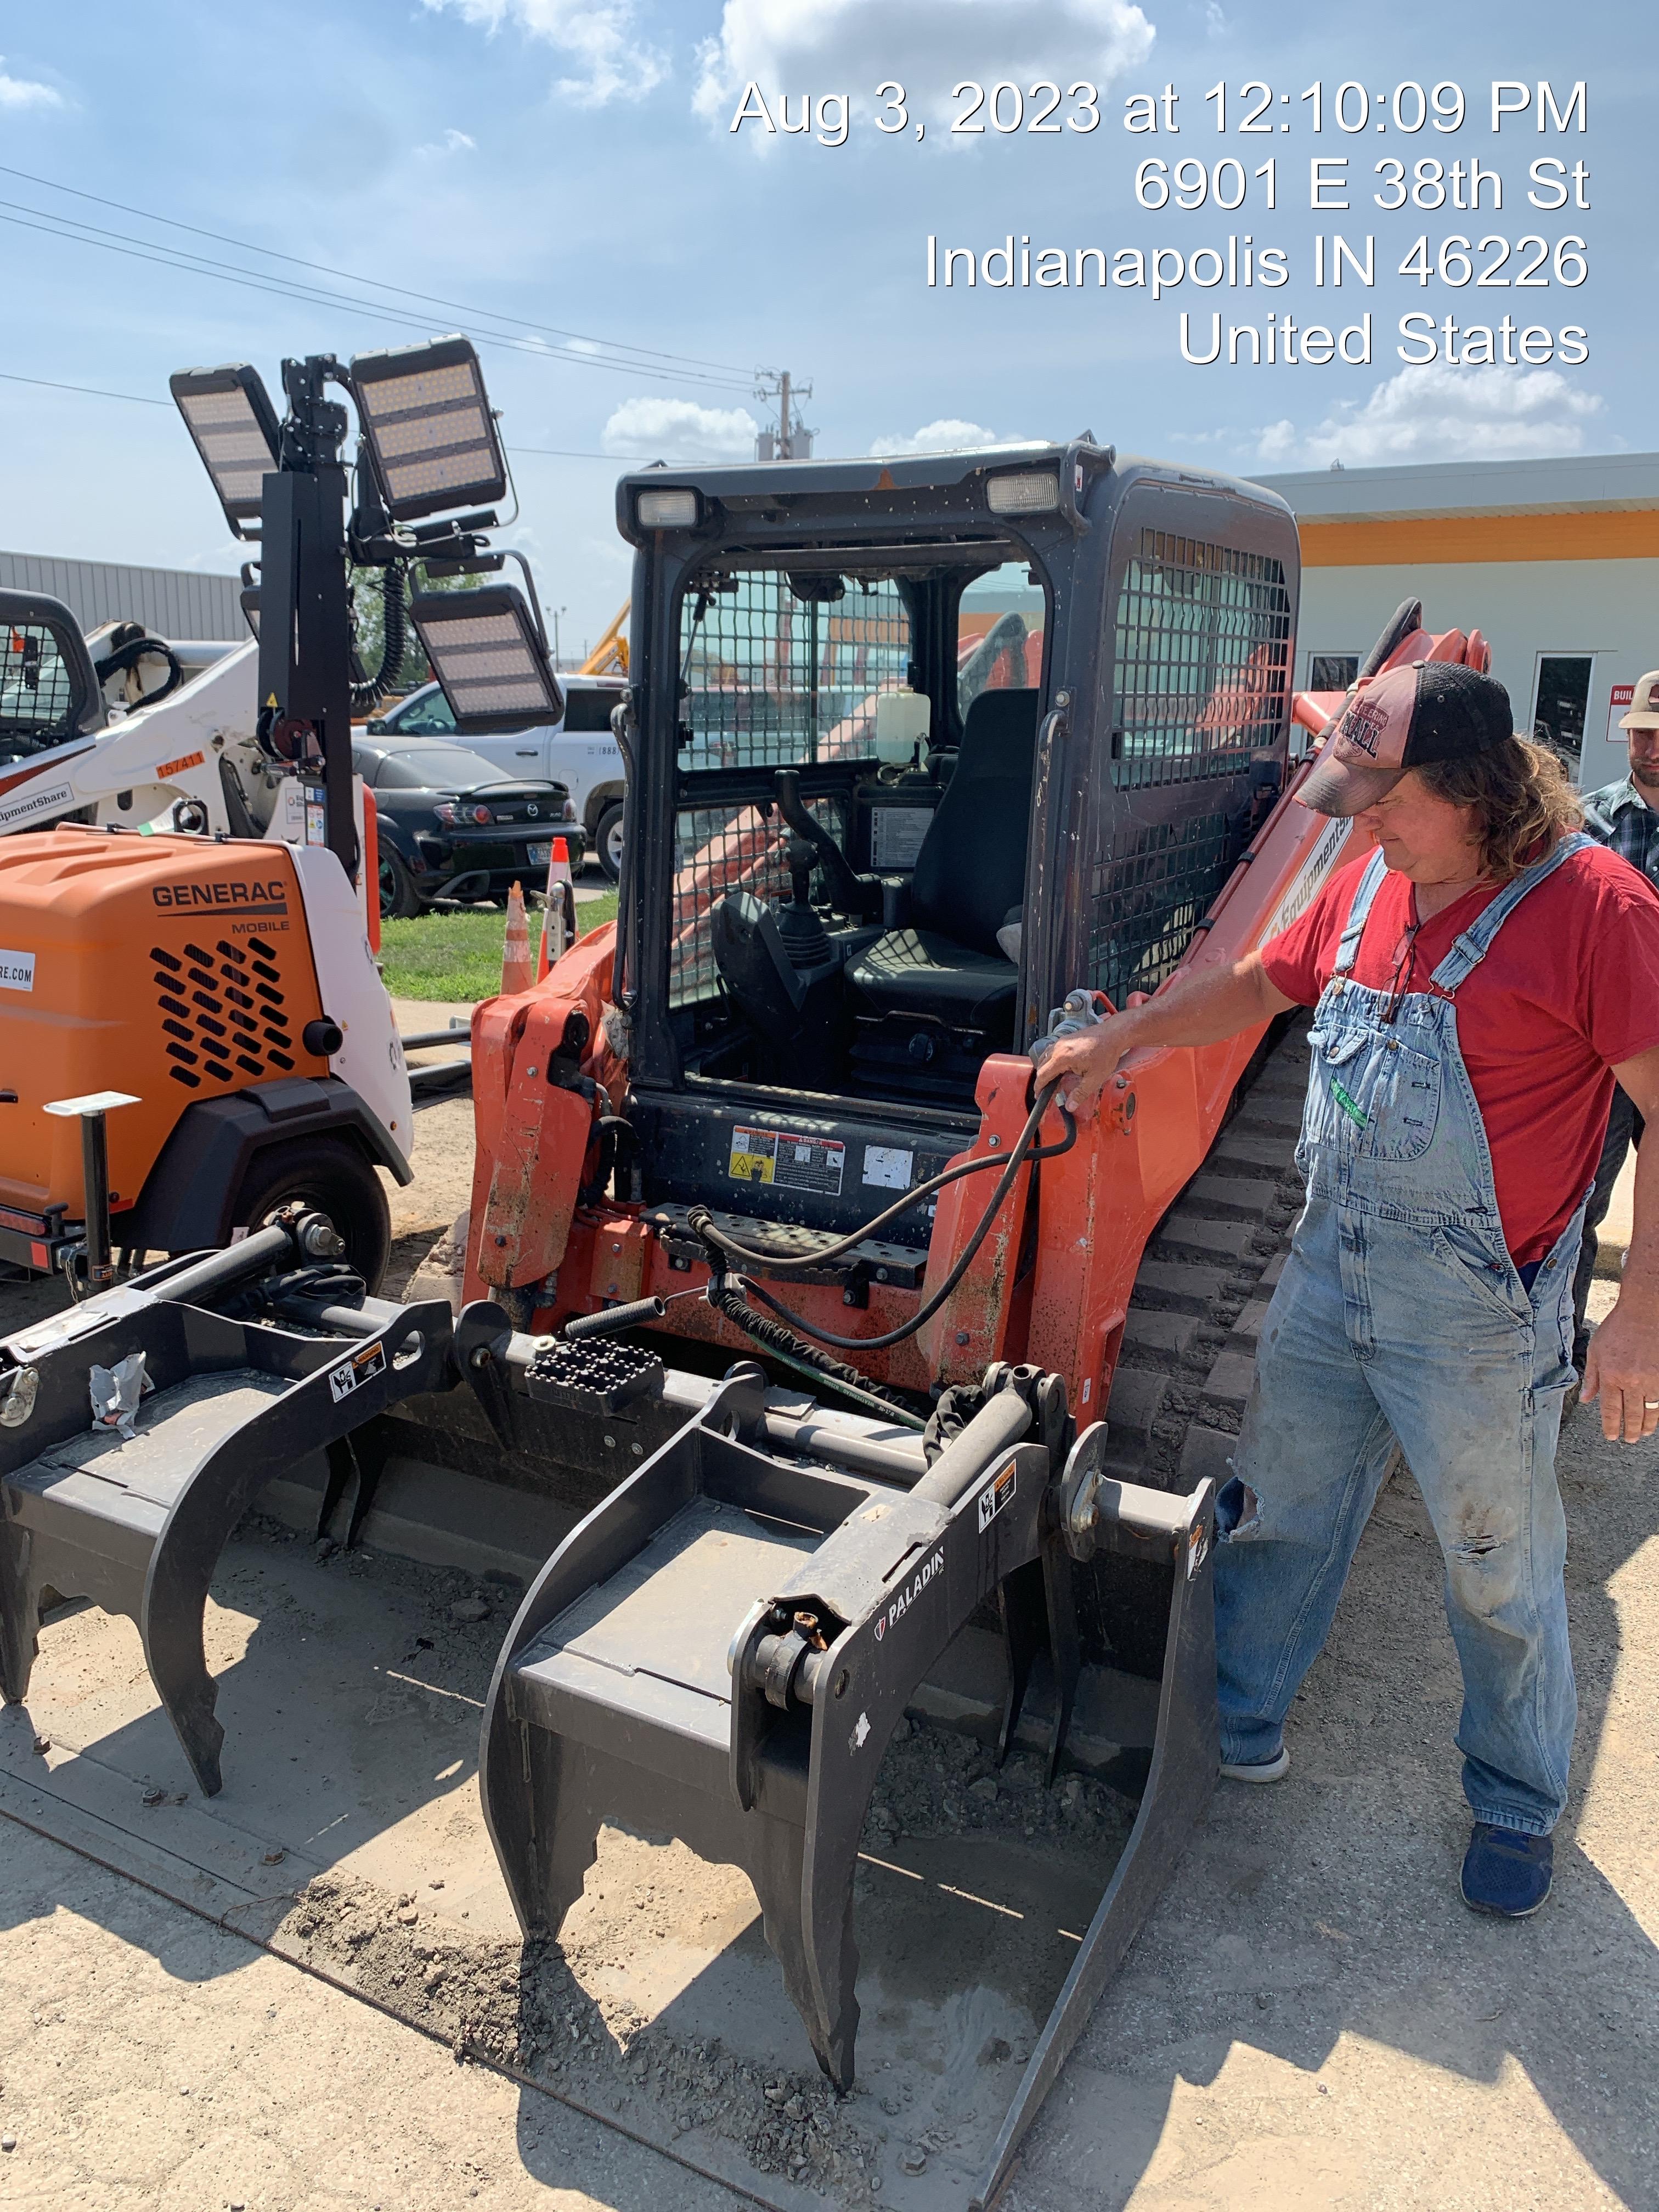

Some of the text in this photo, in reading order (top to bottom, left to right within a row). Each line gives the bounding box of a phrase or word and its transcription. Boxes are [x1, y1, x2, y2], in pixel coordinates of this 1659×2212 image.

[158, 752, 203, 778] 157411
[0, 790, 67, 821] ipmentShare
[153, 881, 285, 906] GENERAC
[232, 921, 290, 934] MOBILE
[889, 1545, 944, 1627] PALADIN
